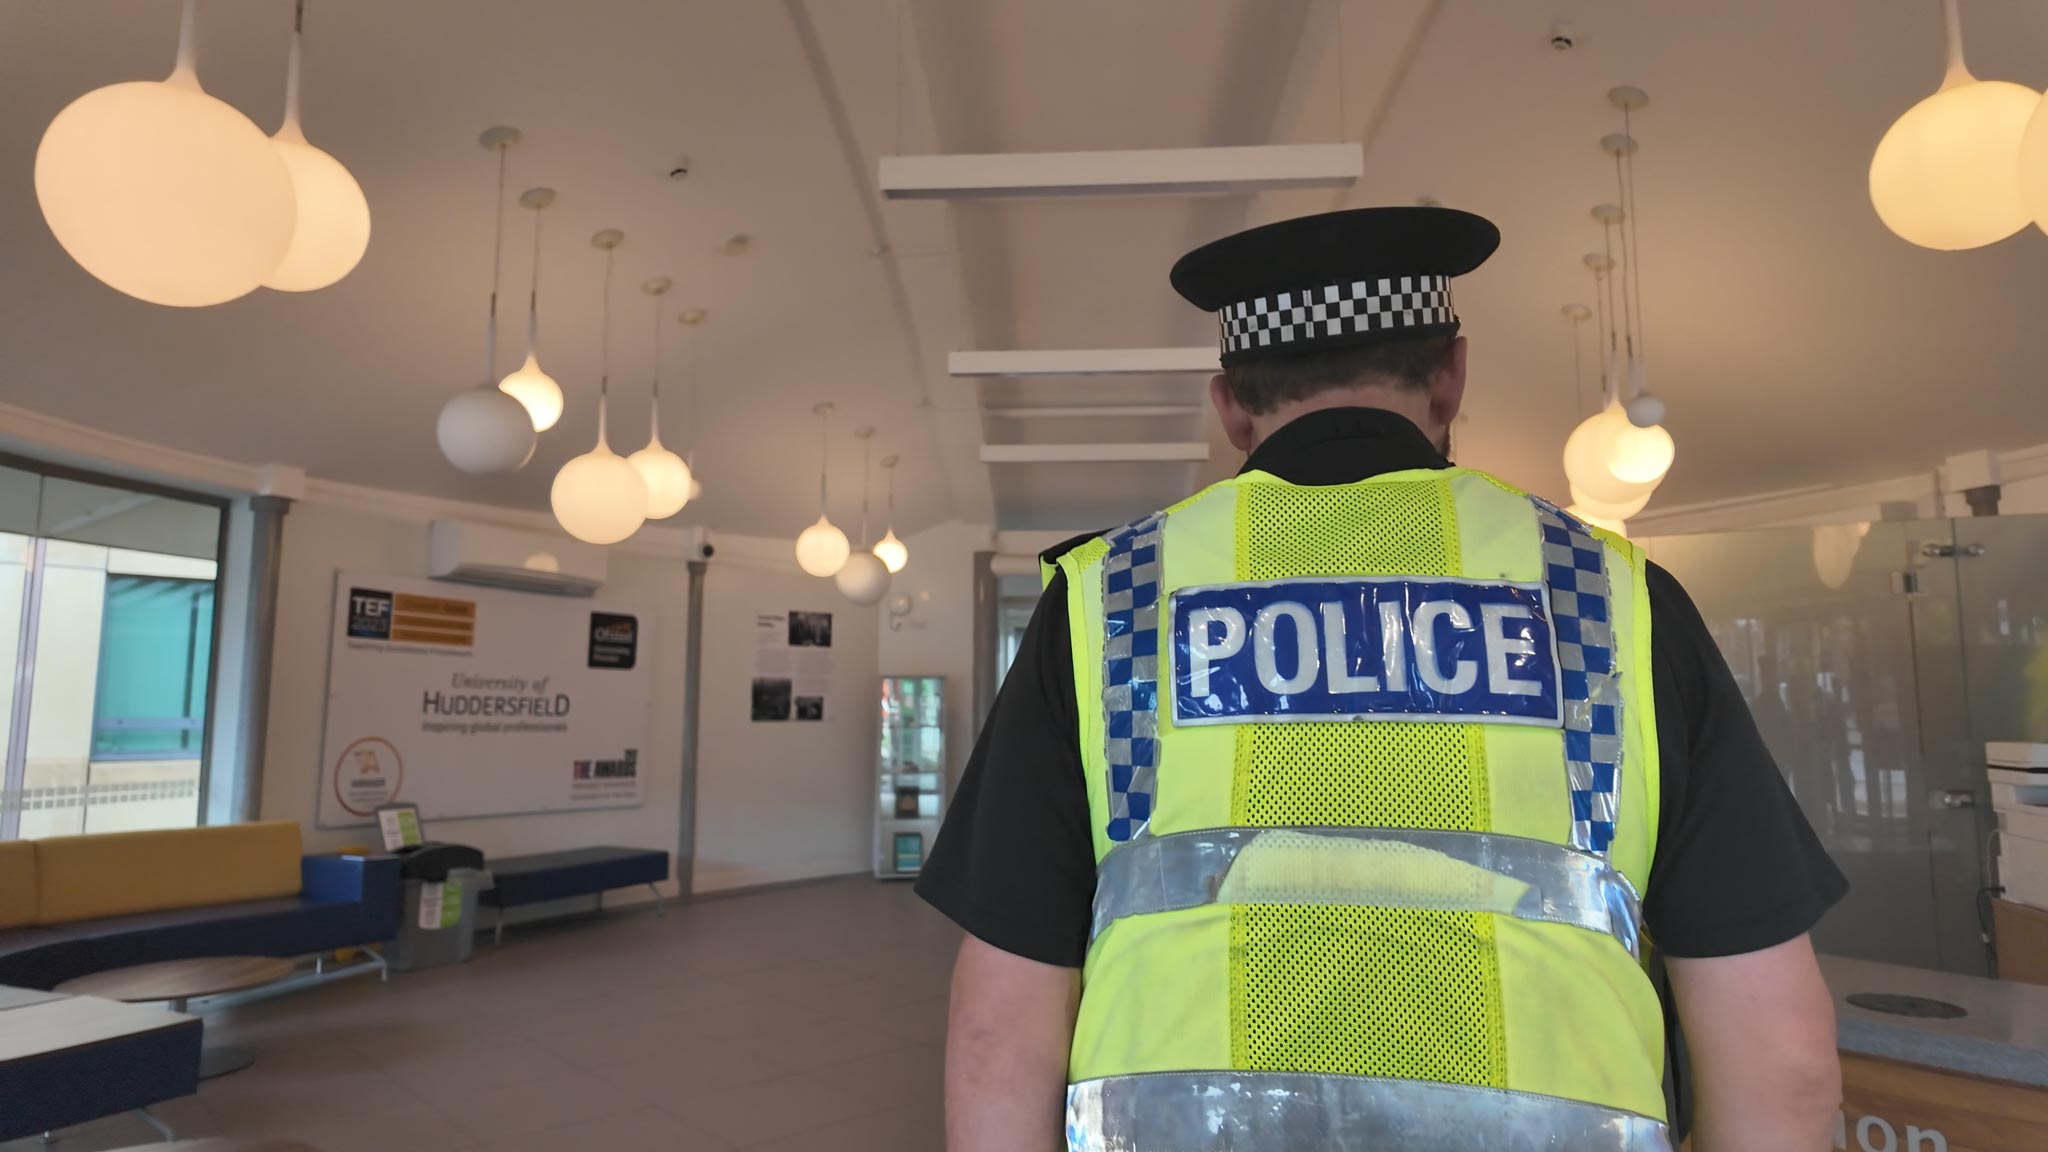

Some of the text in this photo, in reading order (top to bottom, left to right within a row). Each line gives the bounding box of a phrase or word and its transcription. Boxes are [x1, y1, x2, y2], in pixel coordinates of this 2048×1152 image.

[352, 596, 390, 617] TEF
[1188, 599, 1542, 698] POLICE
[451, 672, 550, 694] University of
